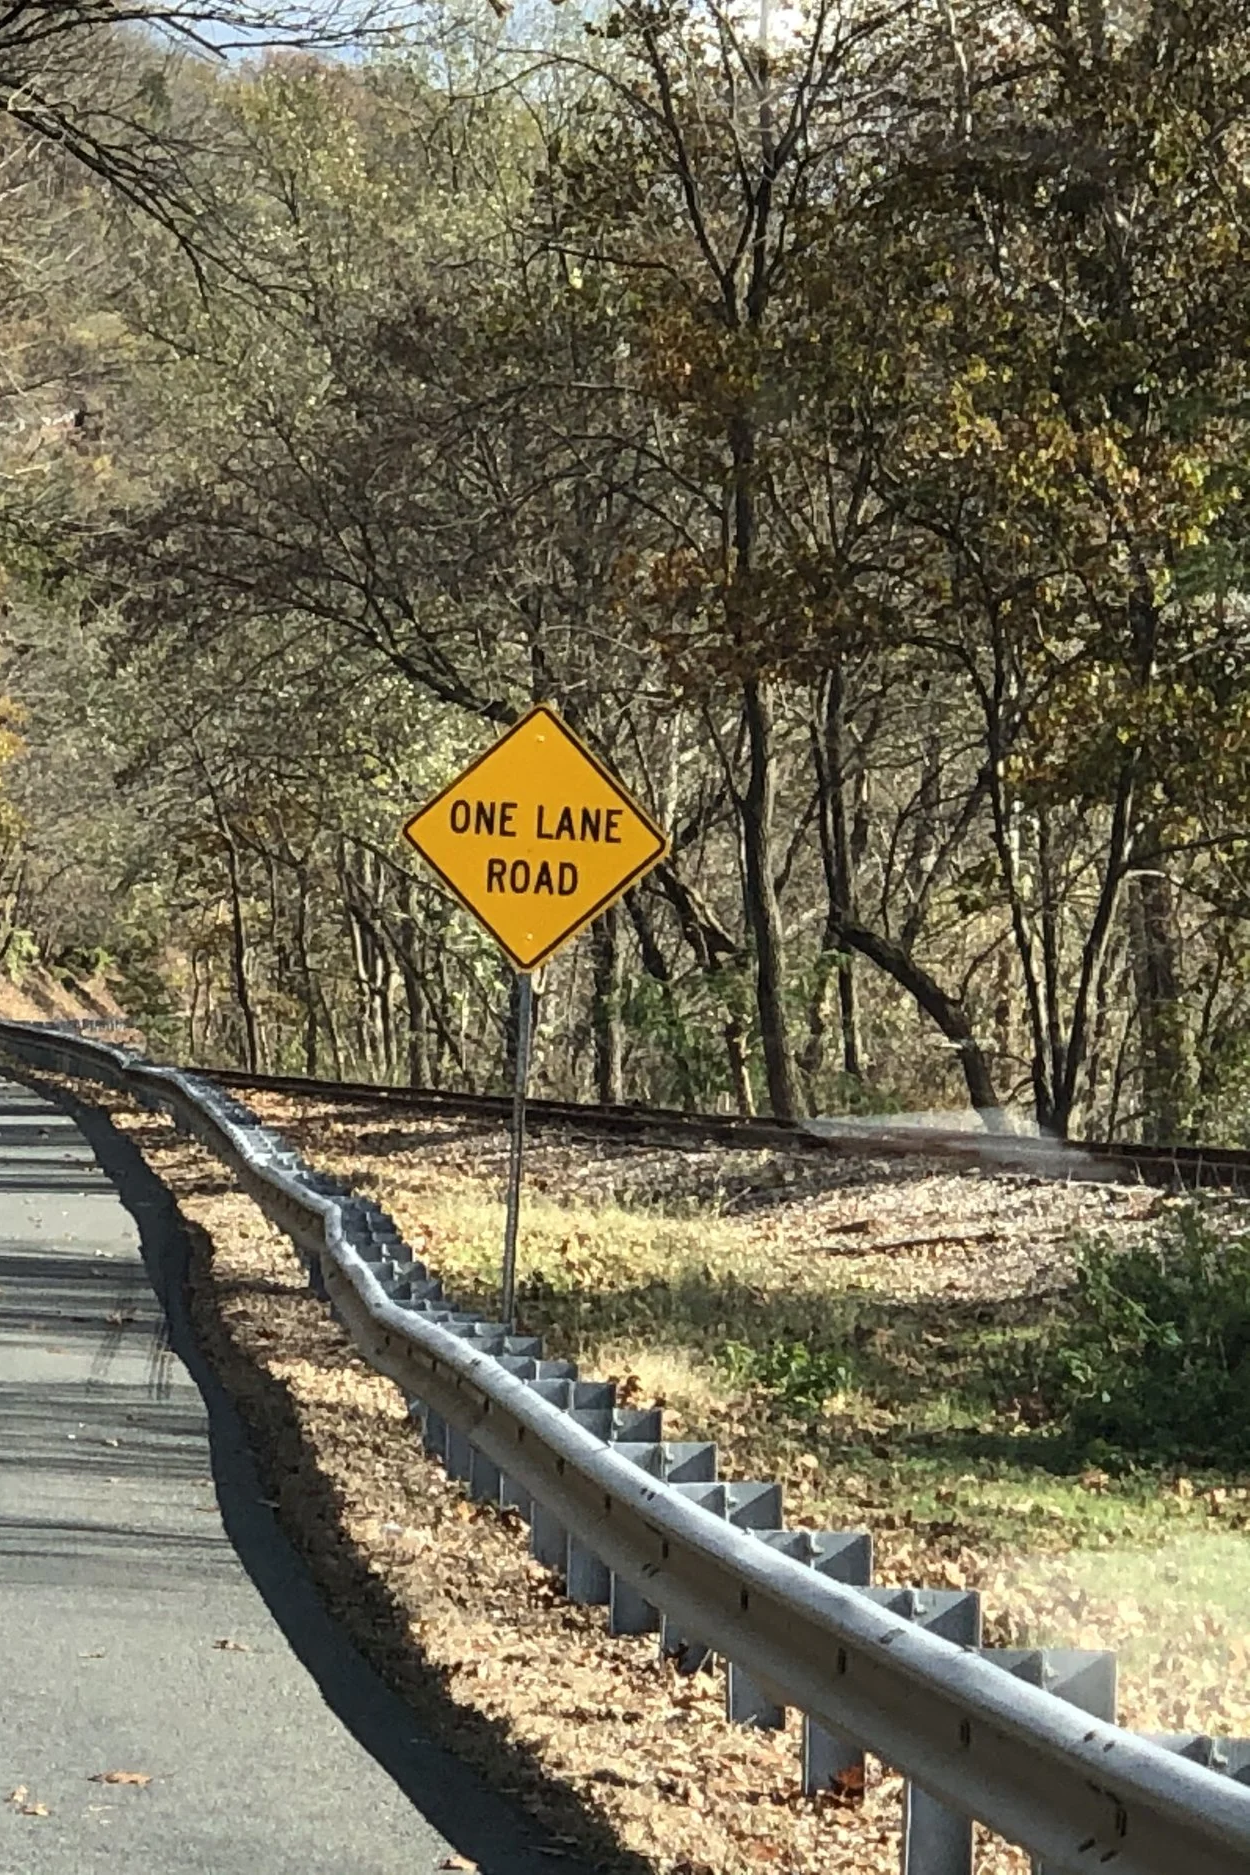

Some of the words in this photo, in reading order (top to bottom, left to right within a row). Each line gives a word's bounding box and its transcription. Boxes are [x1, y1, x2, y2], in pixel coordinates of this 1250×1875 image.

[450, 799, 518, 837] ONE
[536, 804, 623, 844] LANE
[486, 858, 579, 896] ROAD
